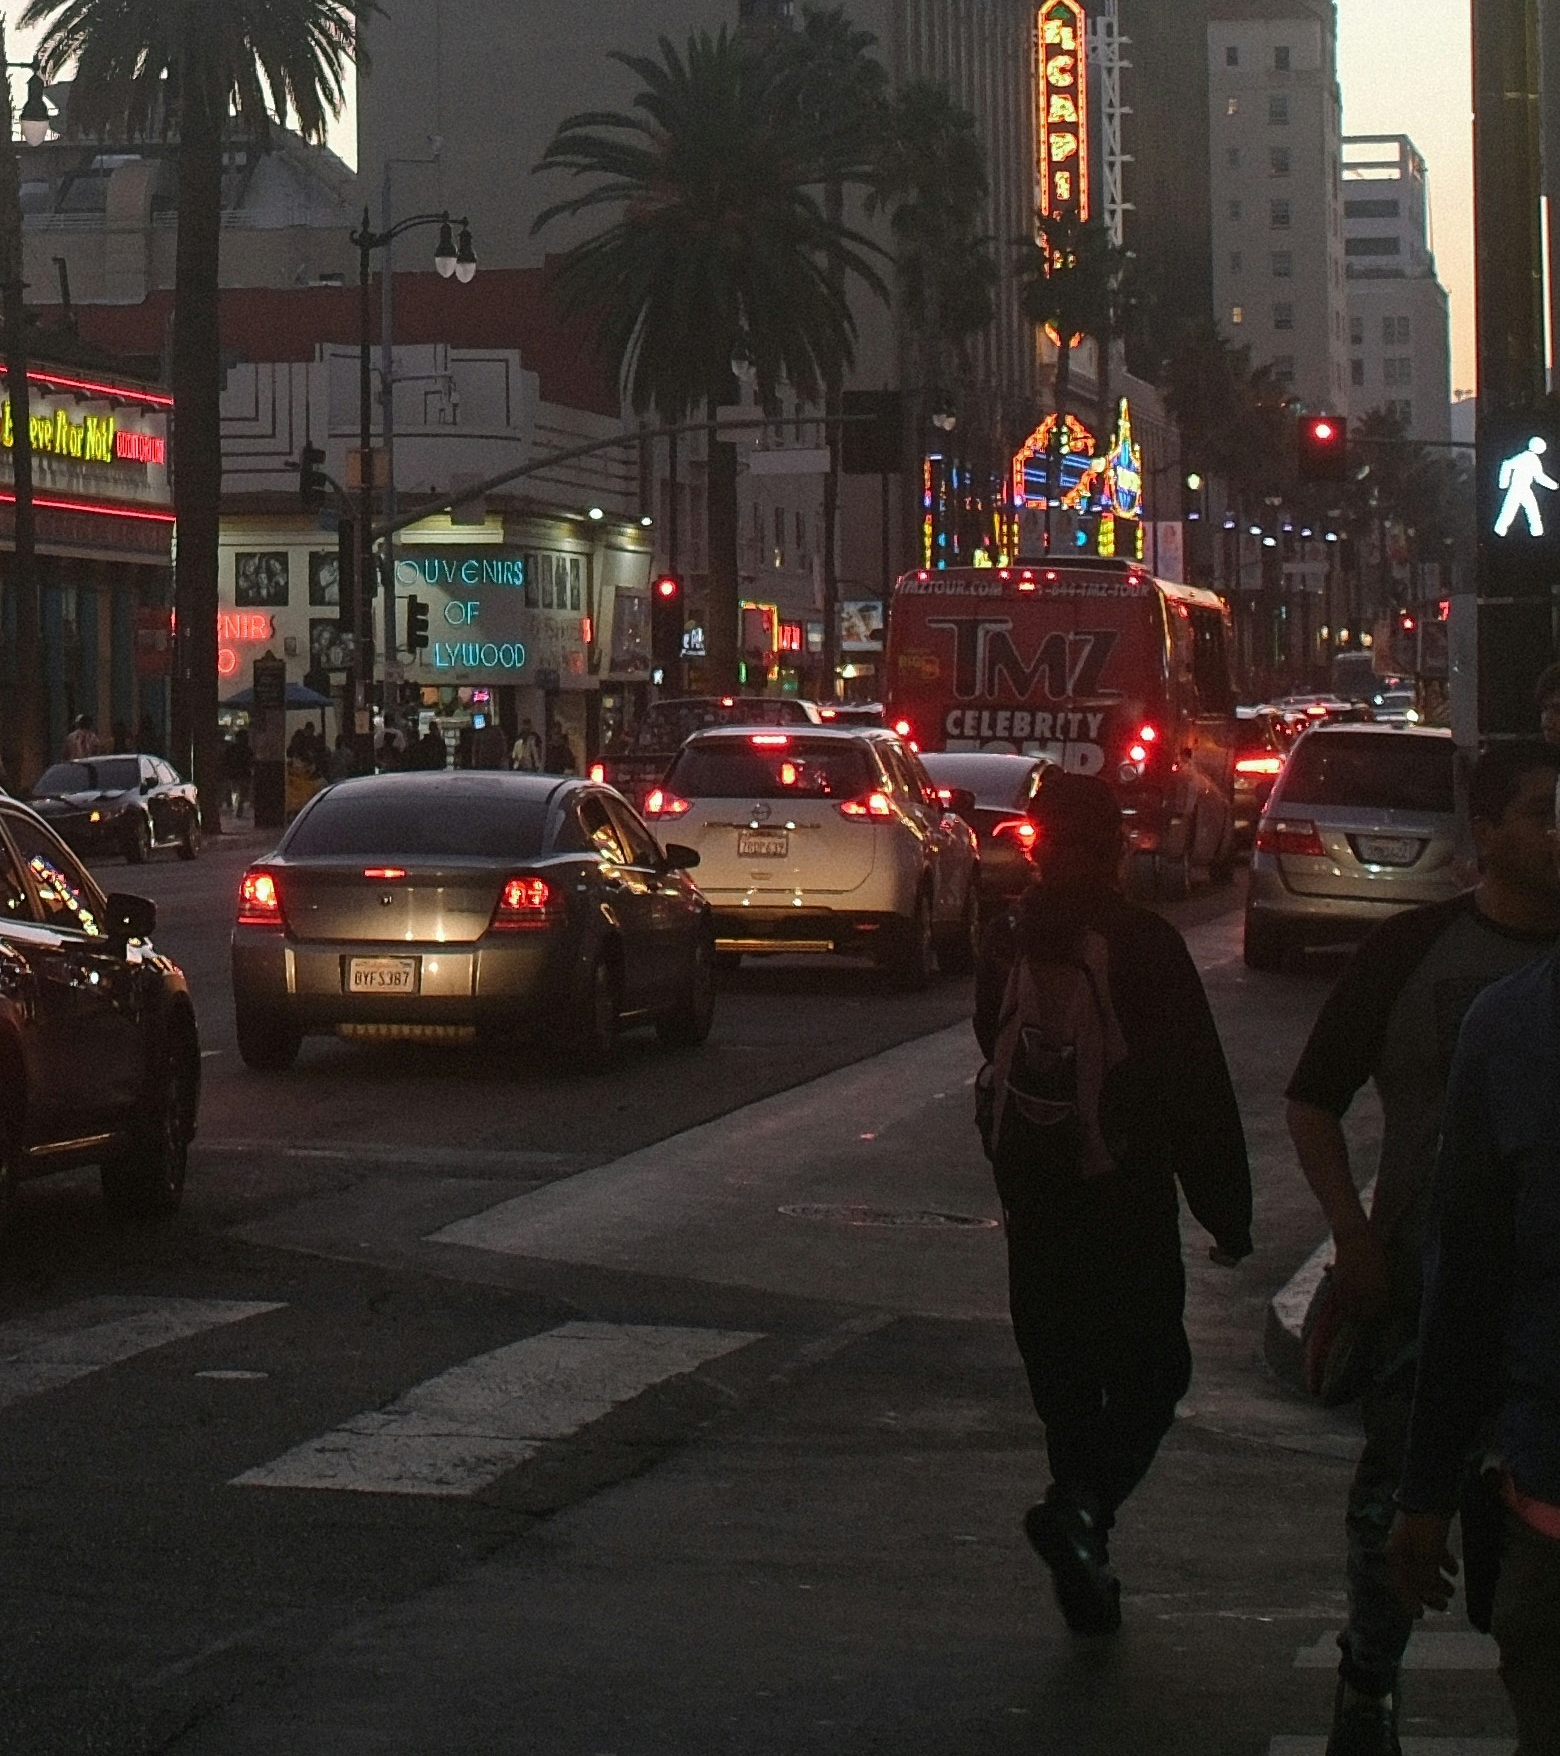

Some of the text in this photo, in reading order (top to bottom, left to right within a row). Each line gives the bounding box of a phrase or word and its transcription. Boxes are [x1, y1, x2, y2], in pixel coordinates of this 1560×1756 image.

[395, 557, 525, 588] OUVENIRS
[444, 599, 481, 626] OF
[926, 615, 1122, 710] TMZ
[945, 709, 1105, 741] CELEBRITY
